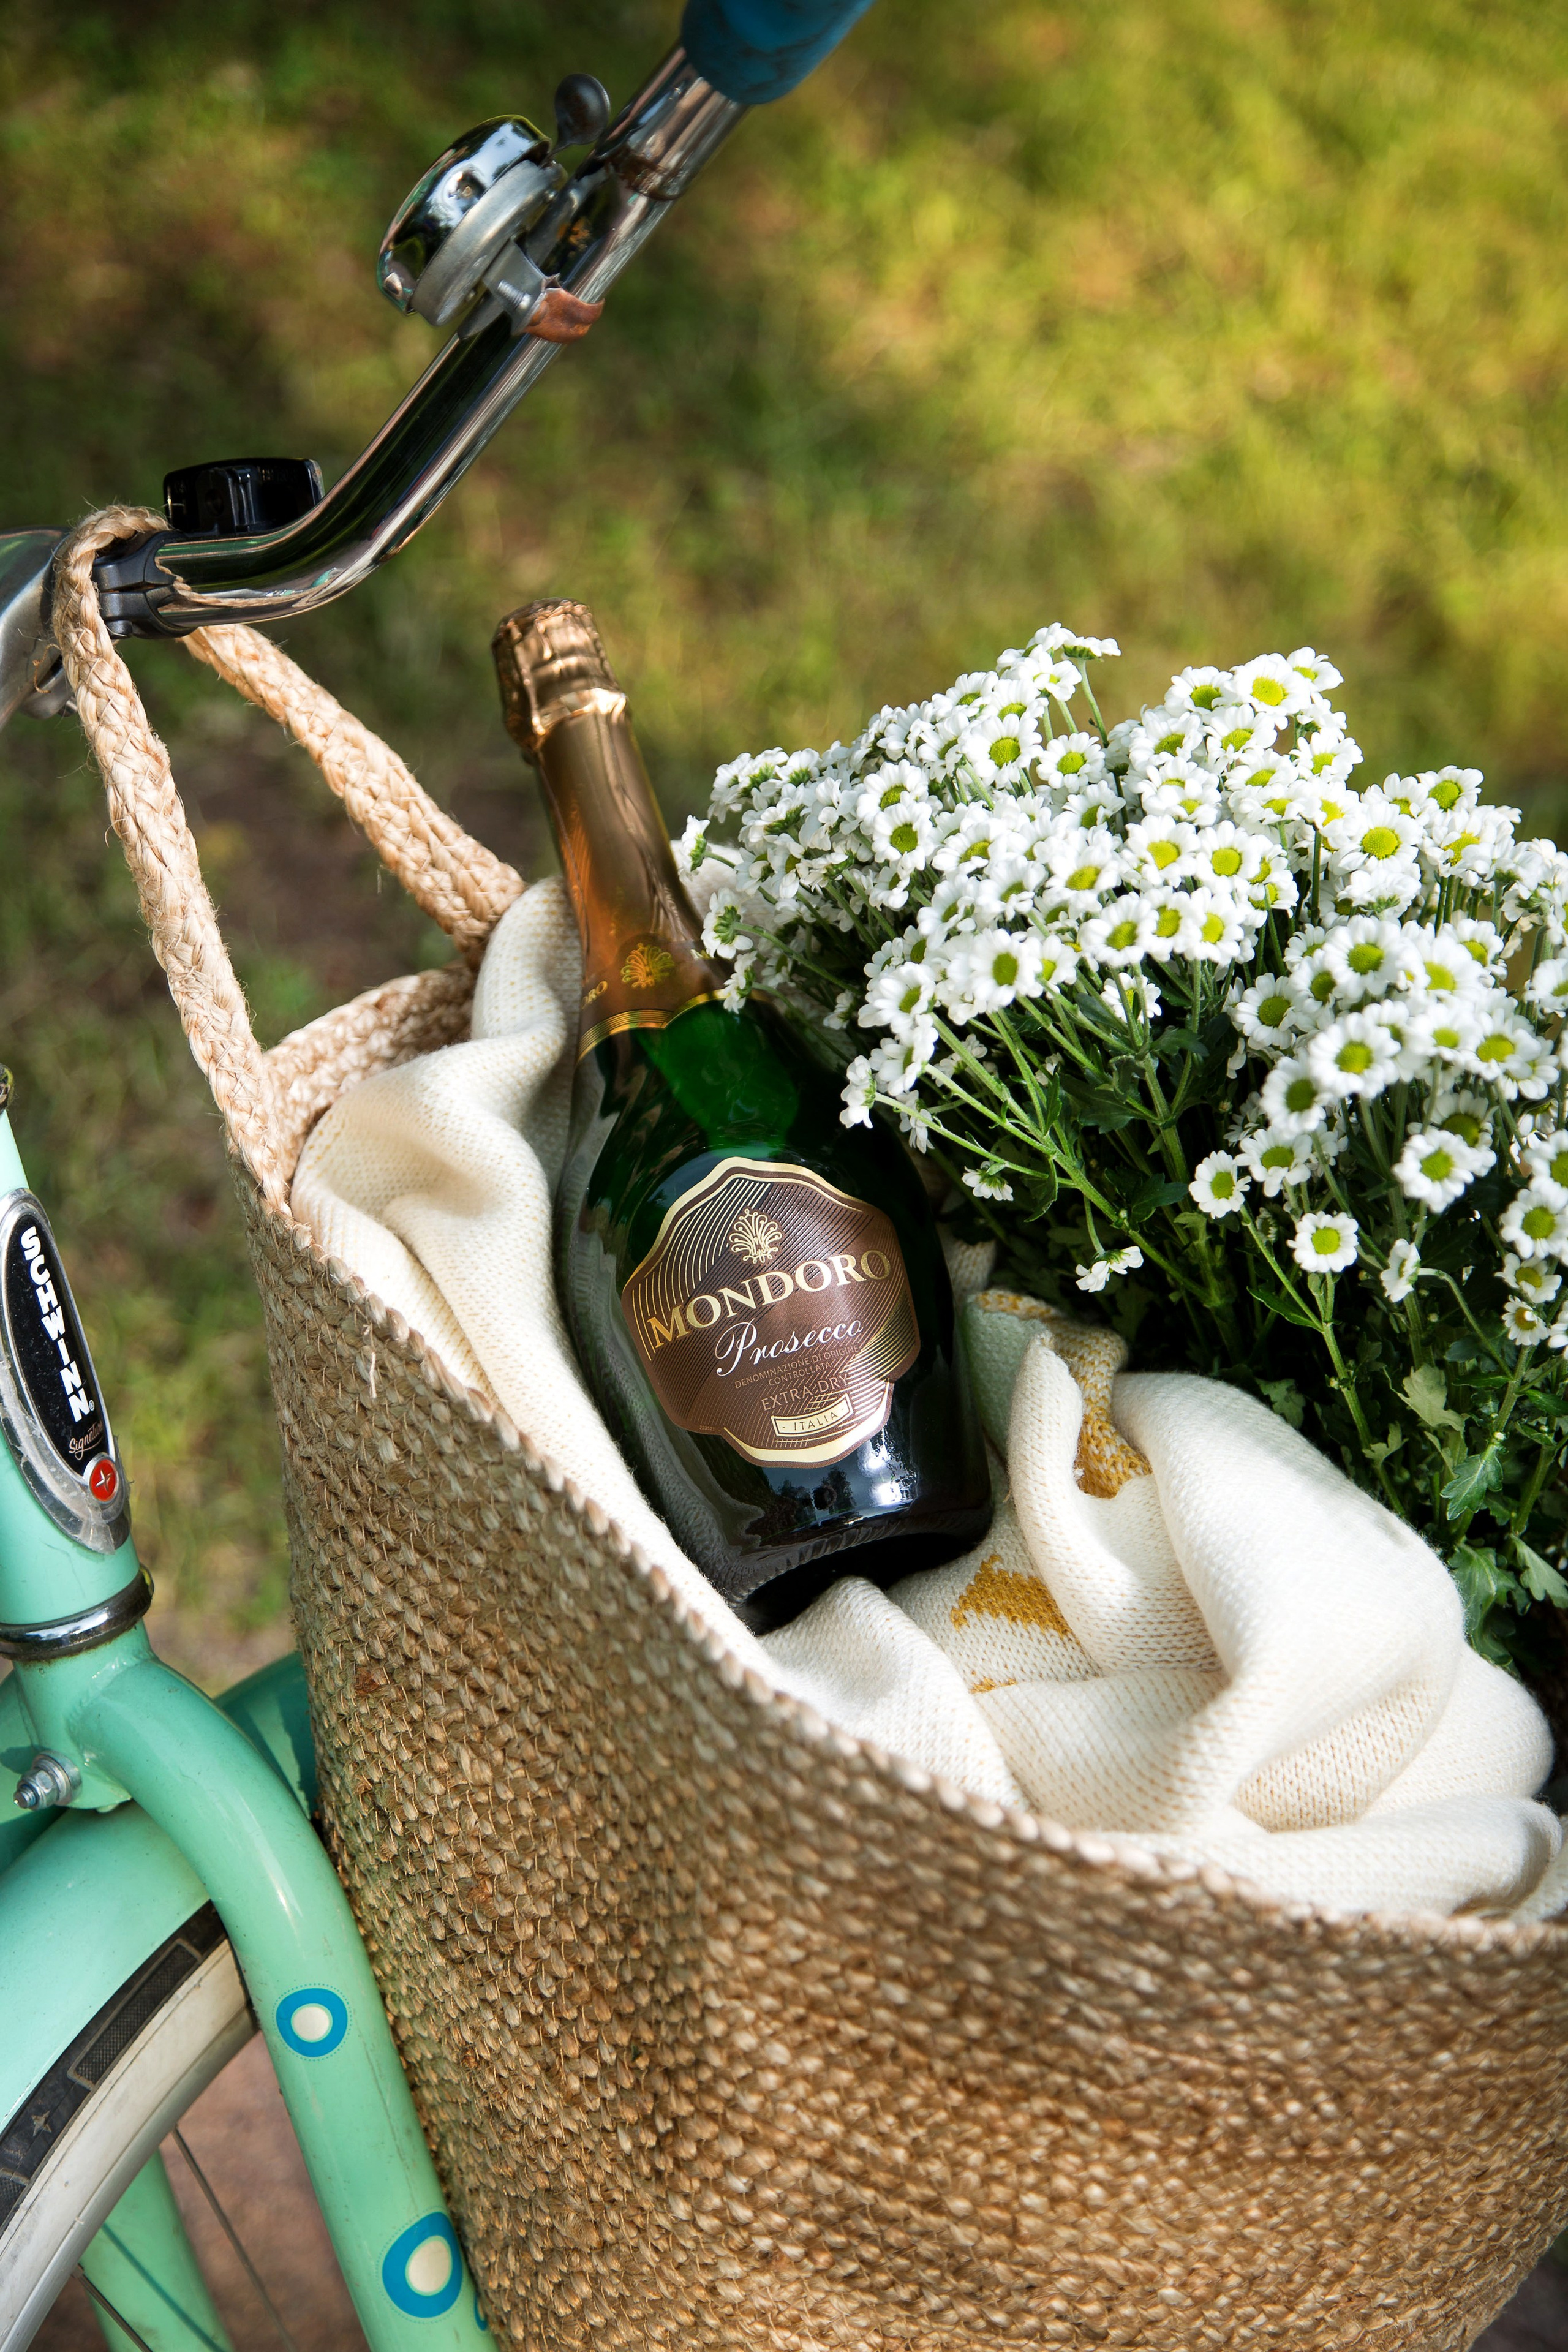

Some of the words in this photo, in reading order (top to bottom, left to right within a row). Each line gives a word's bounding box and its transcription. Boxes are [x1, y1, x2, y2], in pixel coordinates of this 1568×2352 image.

[647, 1250, 892, 1348] MONDORO
[715, 1318, 864, 1376] Prosecco
[736, 1357, 810, 1389] DENOMINAZIONE
[812, 1354, 823, 1363] DI
[824, 1345, 859, 1359] ORIGINE
[761, 1385, 813, 1411] EXTRA
[818, 1374, 849, 1393] DRY
[769, 1362, 832, 1386] CONTROLLATA
[793, 1412, 838, 1431] ITALIA
